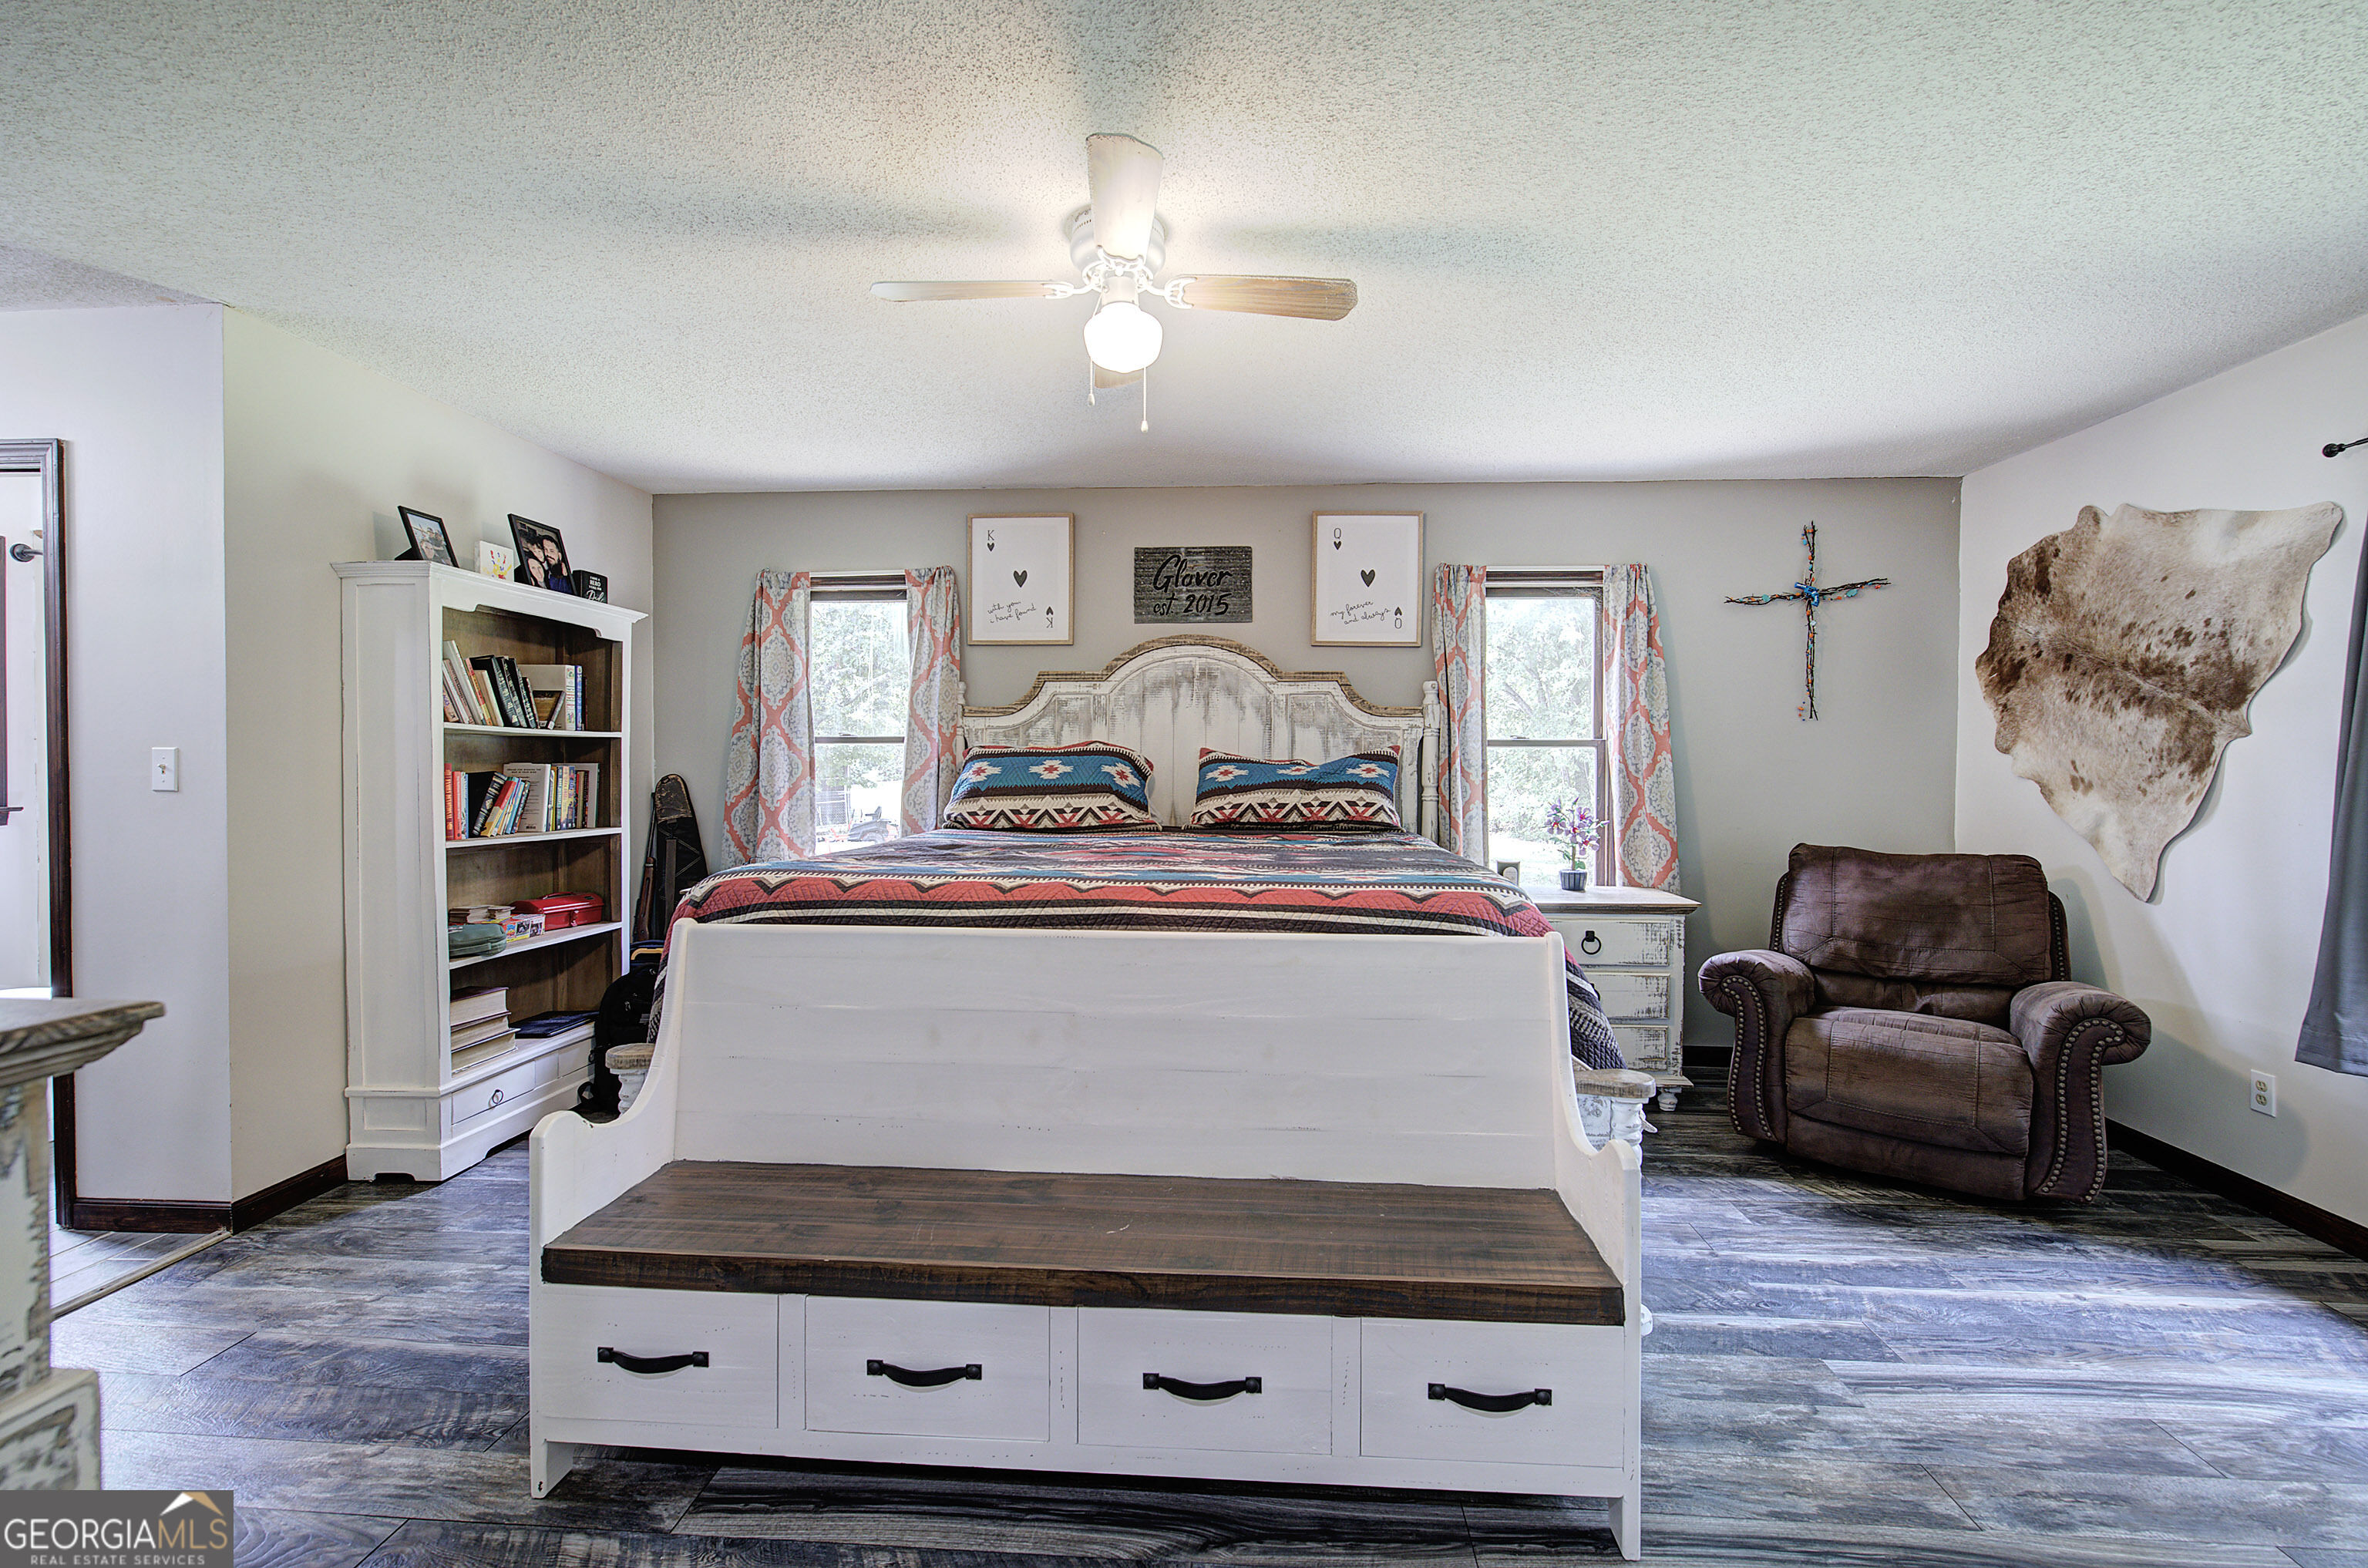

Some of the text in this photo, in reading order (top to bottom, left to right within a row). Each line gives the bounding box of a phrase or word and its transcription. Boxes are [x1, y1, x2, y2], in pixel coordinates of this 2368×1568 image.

[987, 530, 995, 541] K
[1334, 527, 1342, 539] Q
[1153, 554, 1233, 593] Glover
[987, 601, 1021, 614] with you
[995, 614, 1013, 622] have
[1014, 603, 1036, 621] found
[1182, 593, 1232, 616] 2015
[1330, 601, 1374, 620] my forever
[1344, 607, 1391, 625] and always
